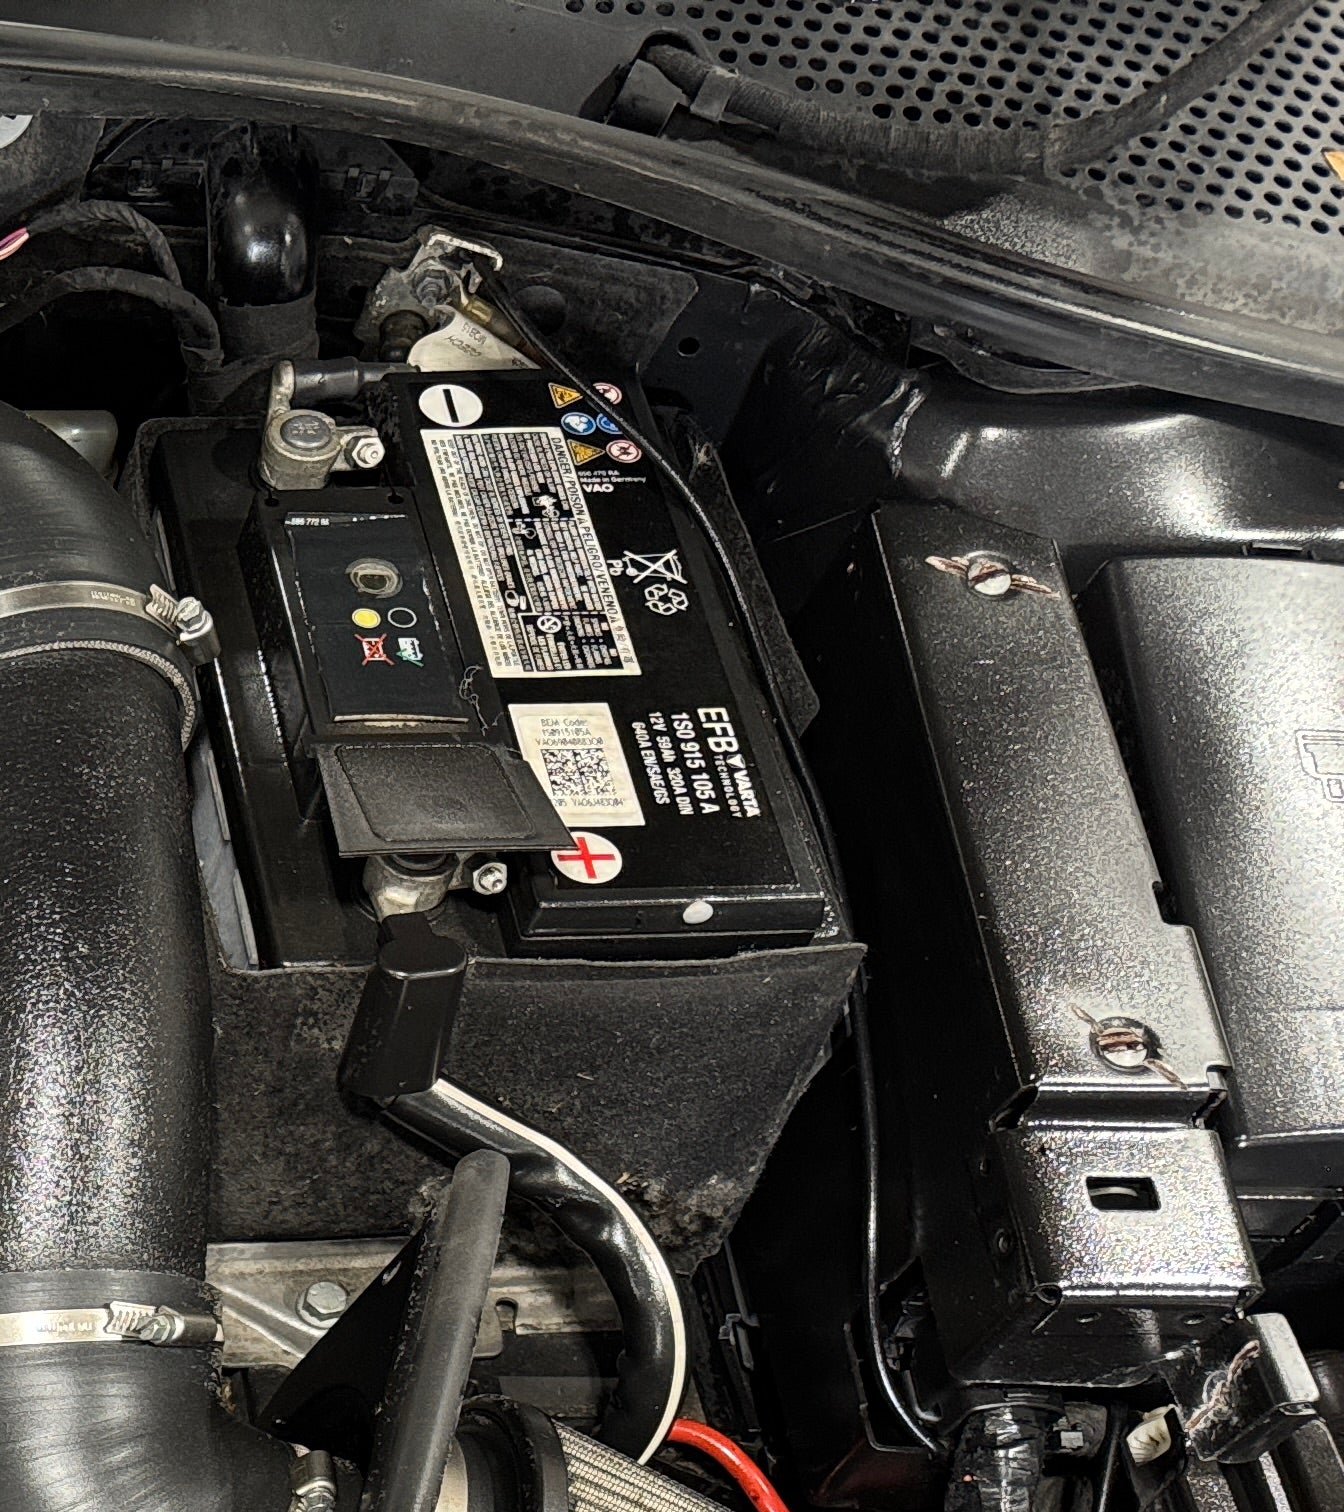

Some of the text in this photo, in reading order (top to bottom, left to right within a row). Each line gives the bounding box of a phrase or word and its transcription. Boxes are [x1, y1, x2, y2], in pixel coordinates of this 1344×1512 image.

[631, 720, 652, 748] 640A
[647, 710, 694, 817] 12V 59Ah 320A DIN
[679, 739, 706, 770] 915
[696, 703, 762, 818] EFB VARTA
[689, 770, 716, 801] 105
[712, 754, 743, 819] TECHNOLOGY
[699, 802, 721, 815] A
